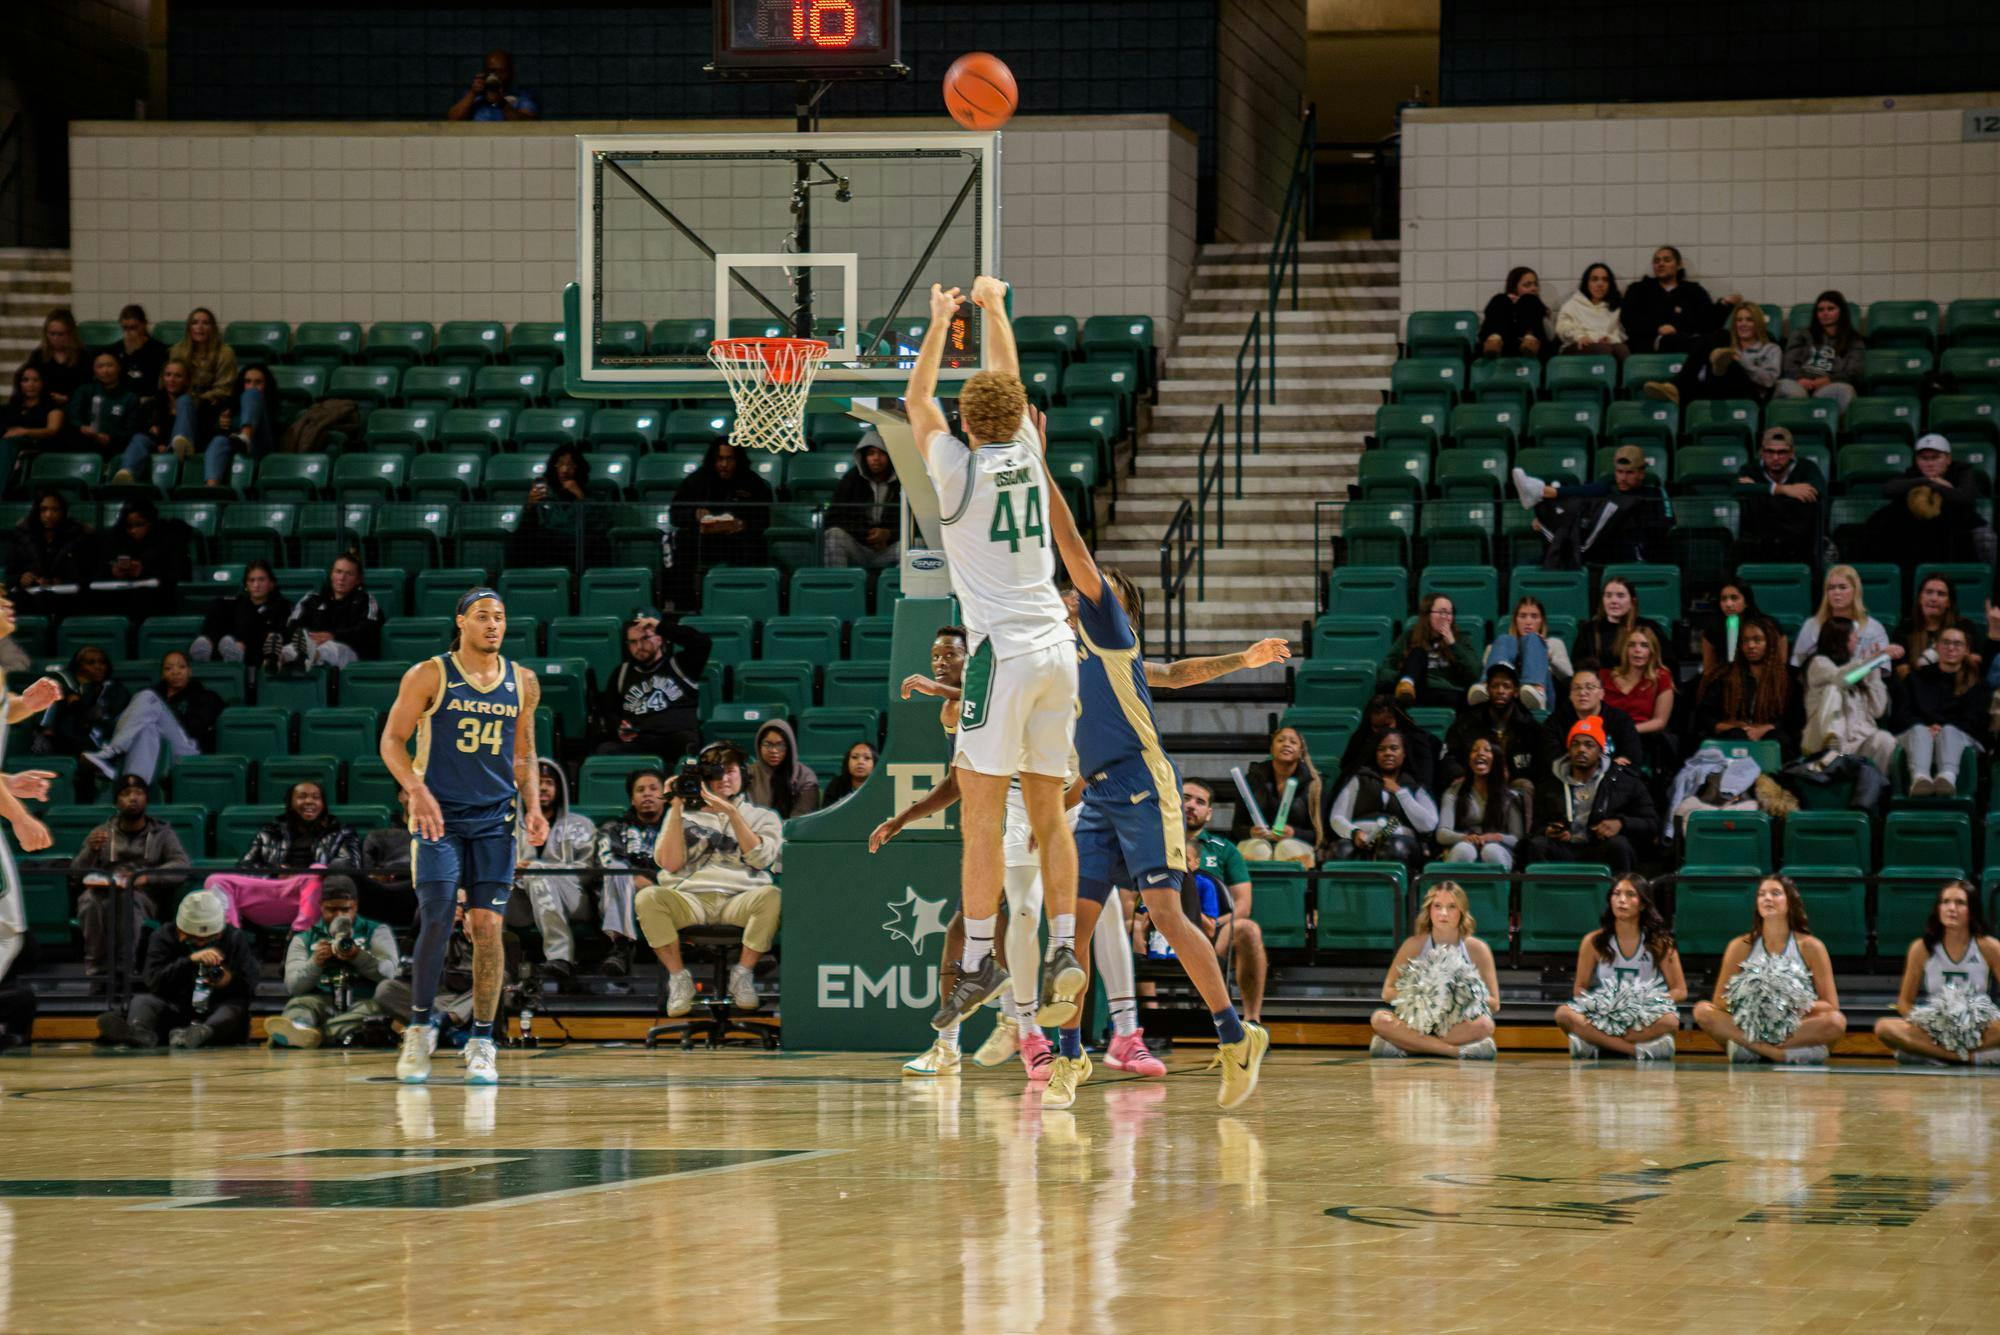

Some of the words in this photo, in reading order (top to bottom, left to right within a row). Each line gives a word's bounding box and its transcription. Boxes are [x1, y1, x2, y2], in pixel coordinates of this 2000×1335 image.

[990, 485, 1045, 553] 44
[446, 698, 518, 717] AKRON
[963, 700, 976, 719] E
[456, 717, 504, 754] 34
[887, 763, 946, 829] E
[1205, 856, 1217, 868] E
[817, 965, 941, 1009] EMU
